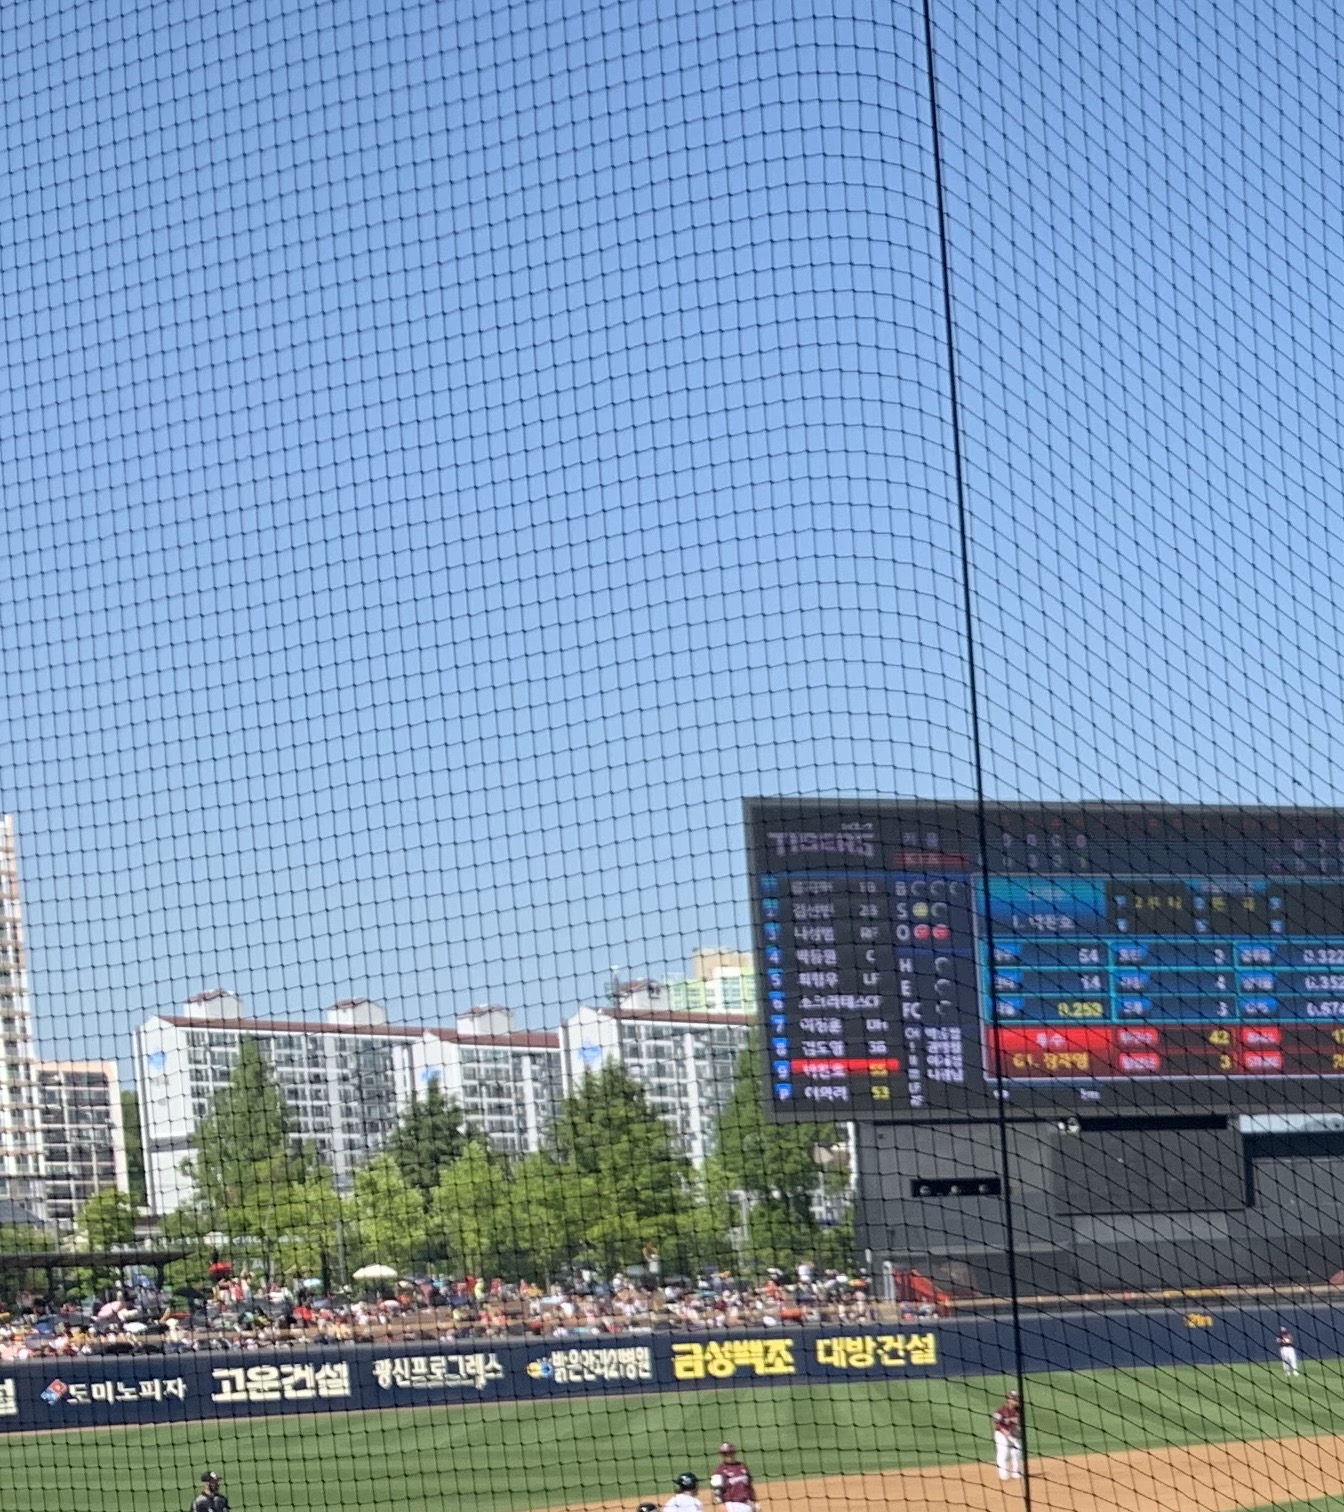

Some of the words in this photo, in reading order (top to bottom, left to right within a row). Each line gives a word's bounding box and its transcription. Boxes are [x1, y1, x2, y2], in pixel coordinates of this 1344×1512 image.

[671, 1338, 796, 1380] 금성백조
[816, 1333, 937, 1368] 대방건설
[211, 1362, 351, 1402] 고운건설
[372, 1353, 505, 1390] 광신프로그레스
[65, 1377, 188, 1405] 도미노피자
